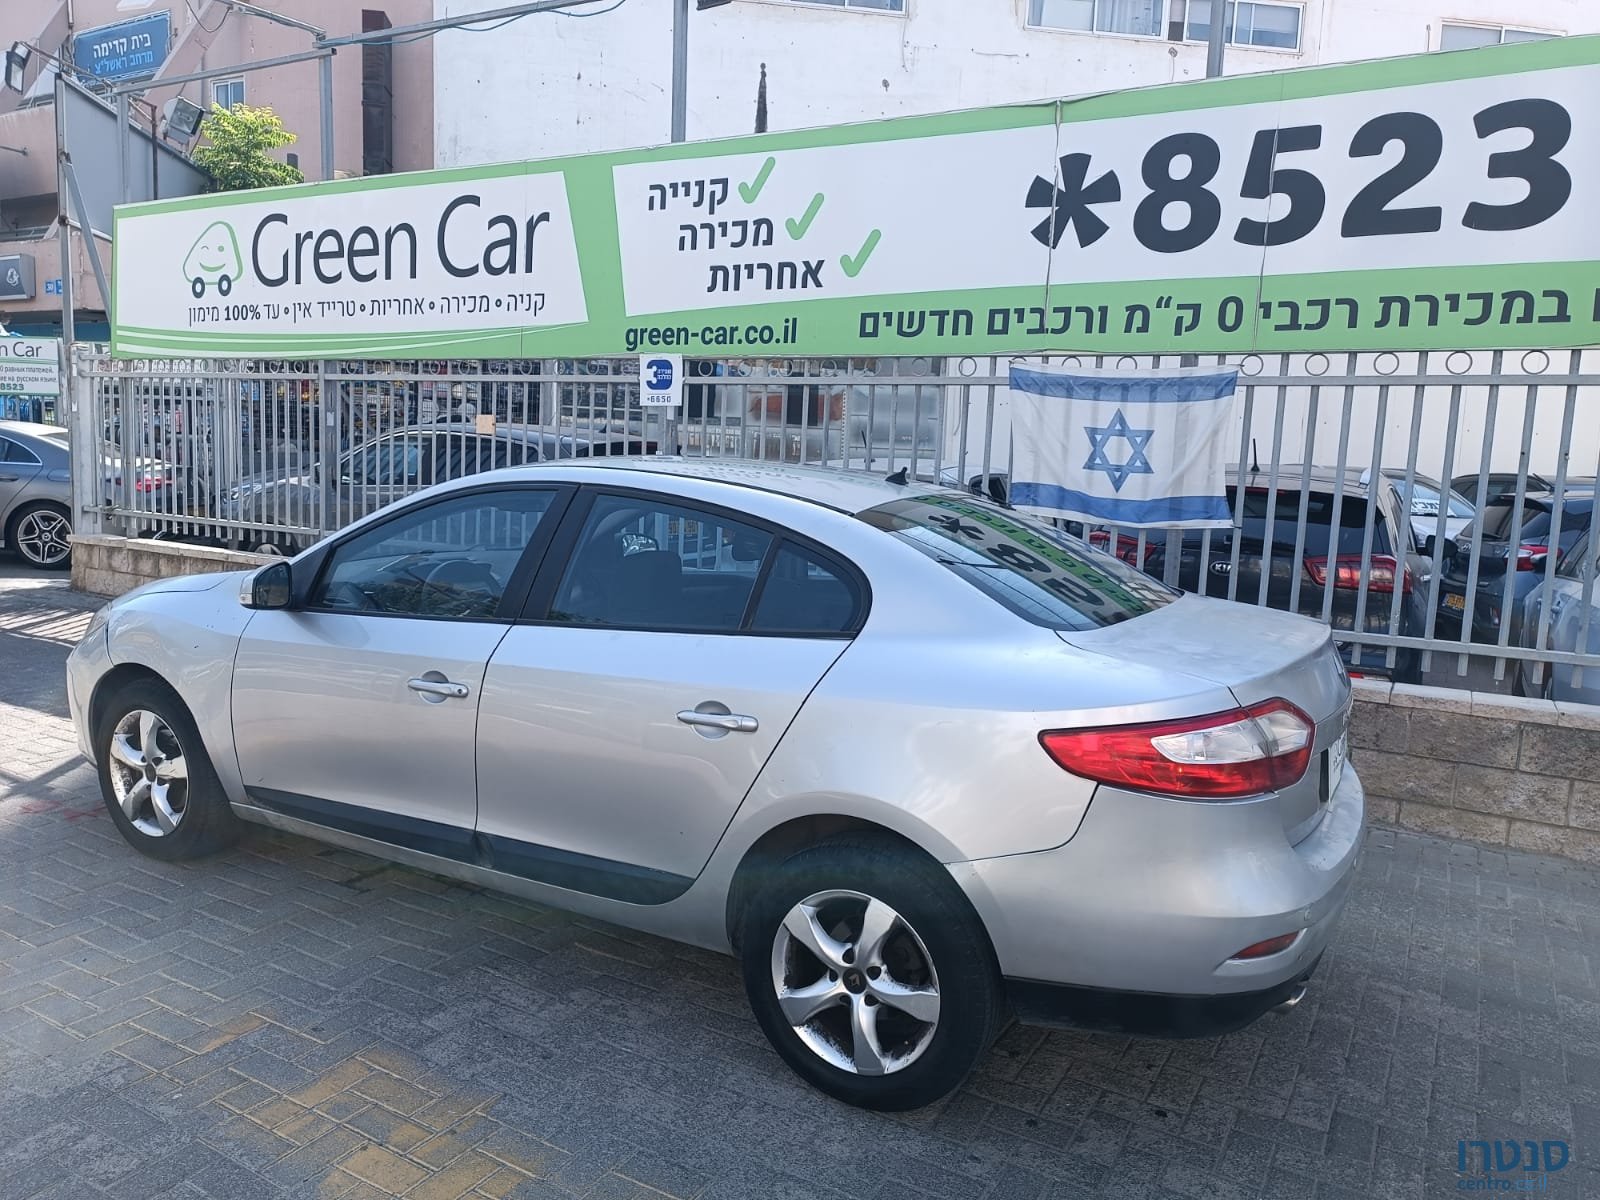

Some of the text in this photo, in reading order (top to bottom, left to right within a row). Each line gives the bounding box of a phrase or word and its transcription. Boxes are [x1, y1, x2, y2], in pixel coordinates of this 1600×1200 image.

[131, 33, 151, 50] בית
[648, 177, 729, 215] קנייה
[252, 194, 550, 288] Green Car
[678, 217, 774, 251] מכירה
[707, 259, 825, 293] אחריות
[188, 293, 545, 328] קניה מכירה אחריות טרייד אין עד 100% מימון
[859, 308, 973, 338] חדשים
[987, 305, 1108, 337] ורכבים
[1218, 295, 1244, 333] 0
[1258, 297, 1359, 331] רכבי
[1374, 289, 1572, 328] במכירת
[13, 341, 43, 358] Car
[625, 317, 798, 352] green-car.co.il
